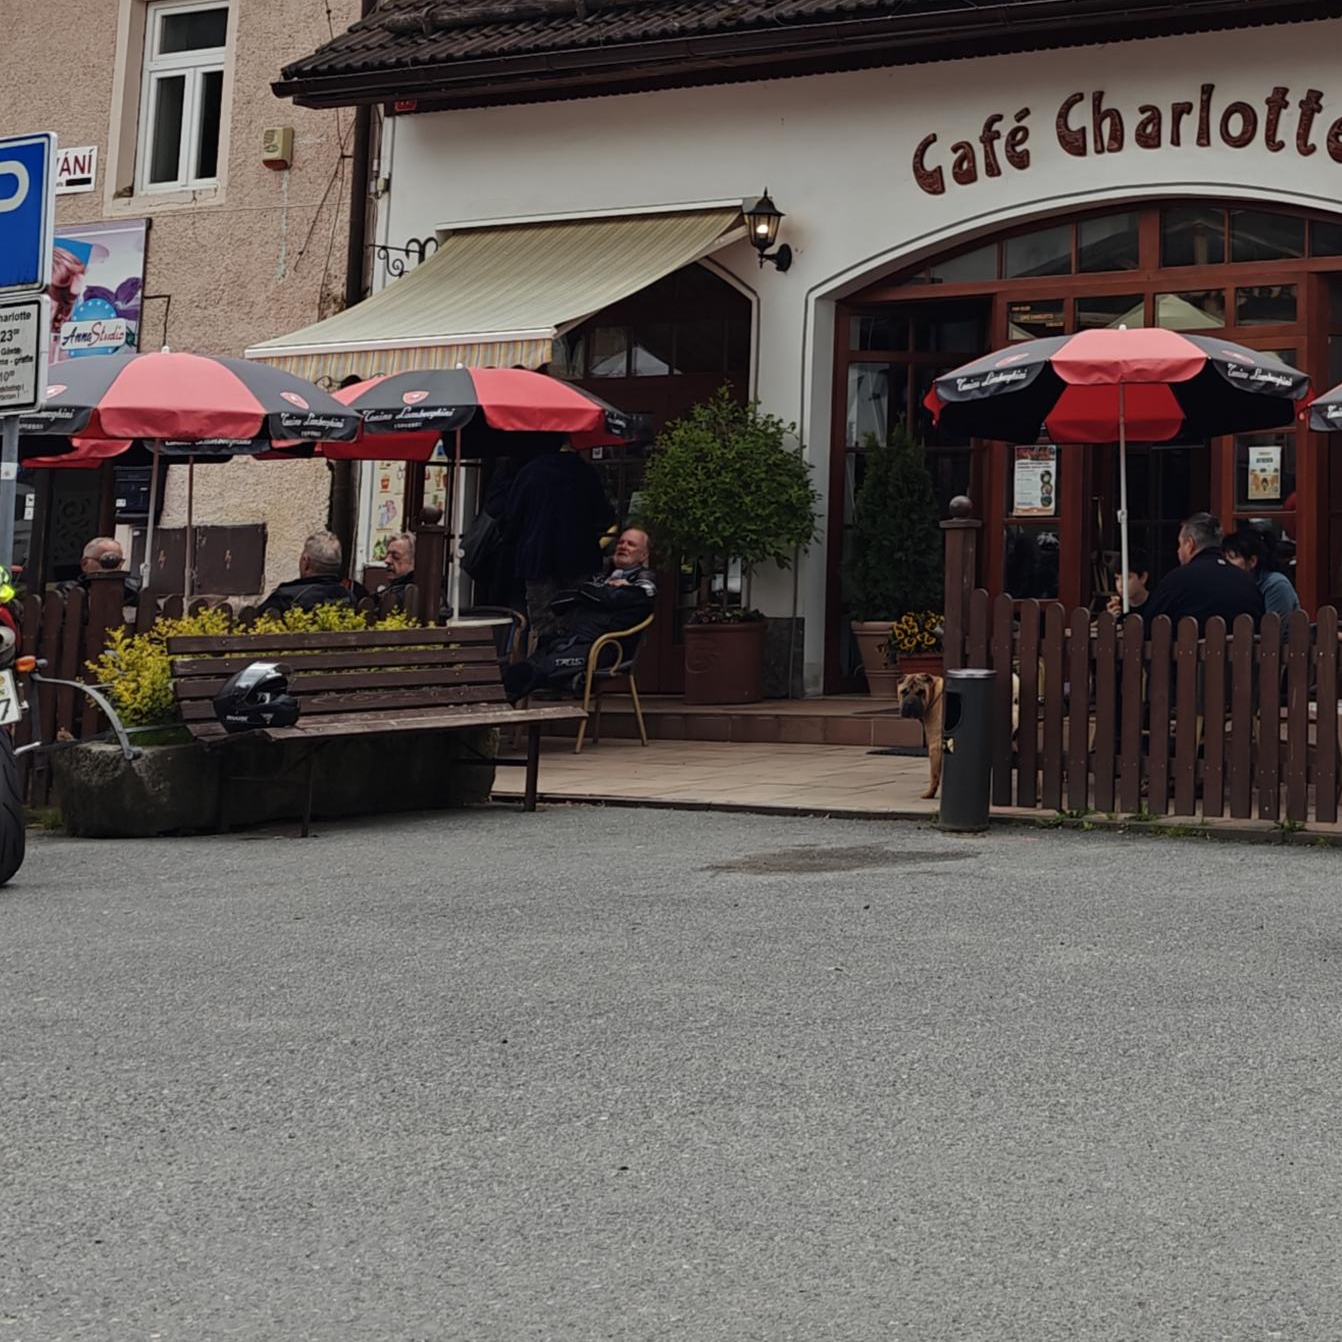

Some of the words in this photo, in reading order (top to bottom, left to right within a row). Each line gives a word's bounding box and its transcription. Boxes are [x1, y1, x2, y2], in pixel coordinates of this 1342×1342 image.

[57, 148, 95, 177] ÁNÍ
[911, 107, 1032, 196] Café
[395, 405, 456, 421] Lamborghini
